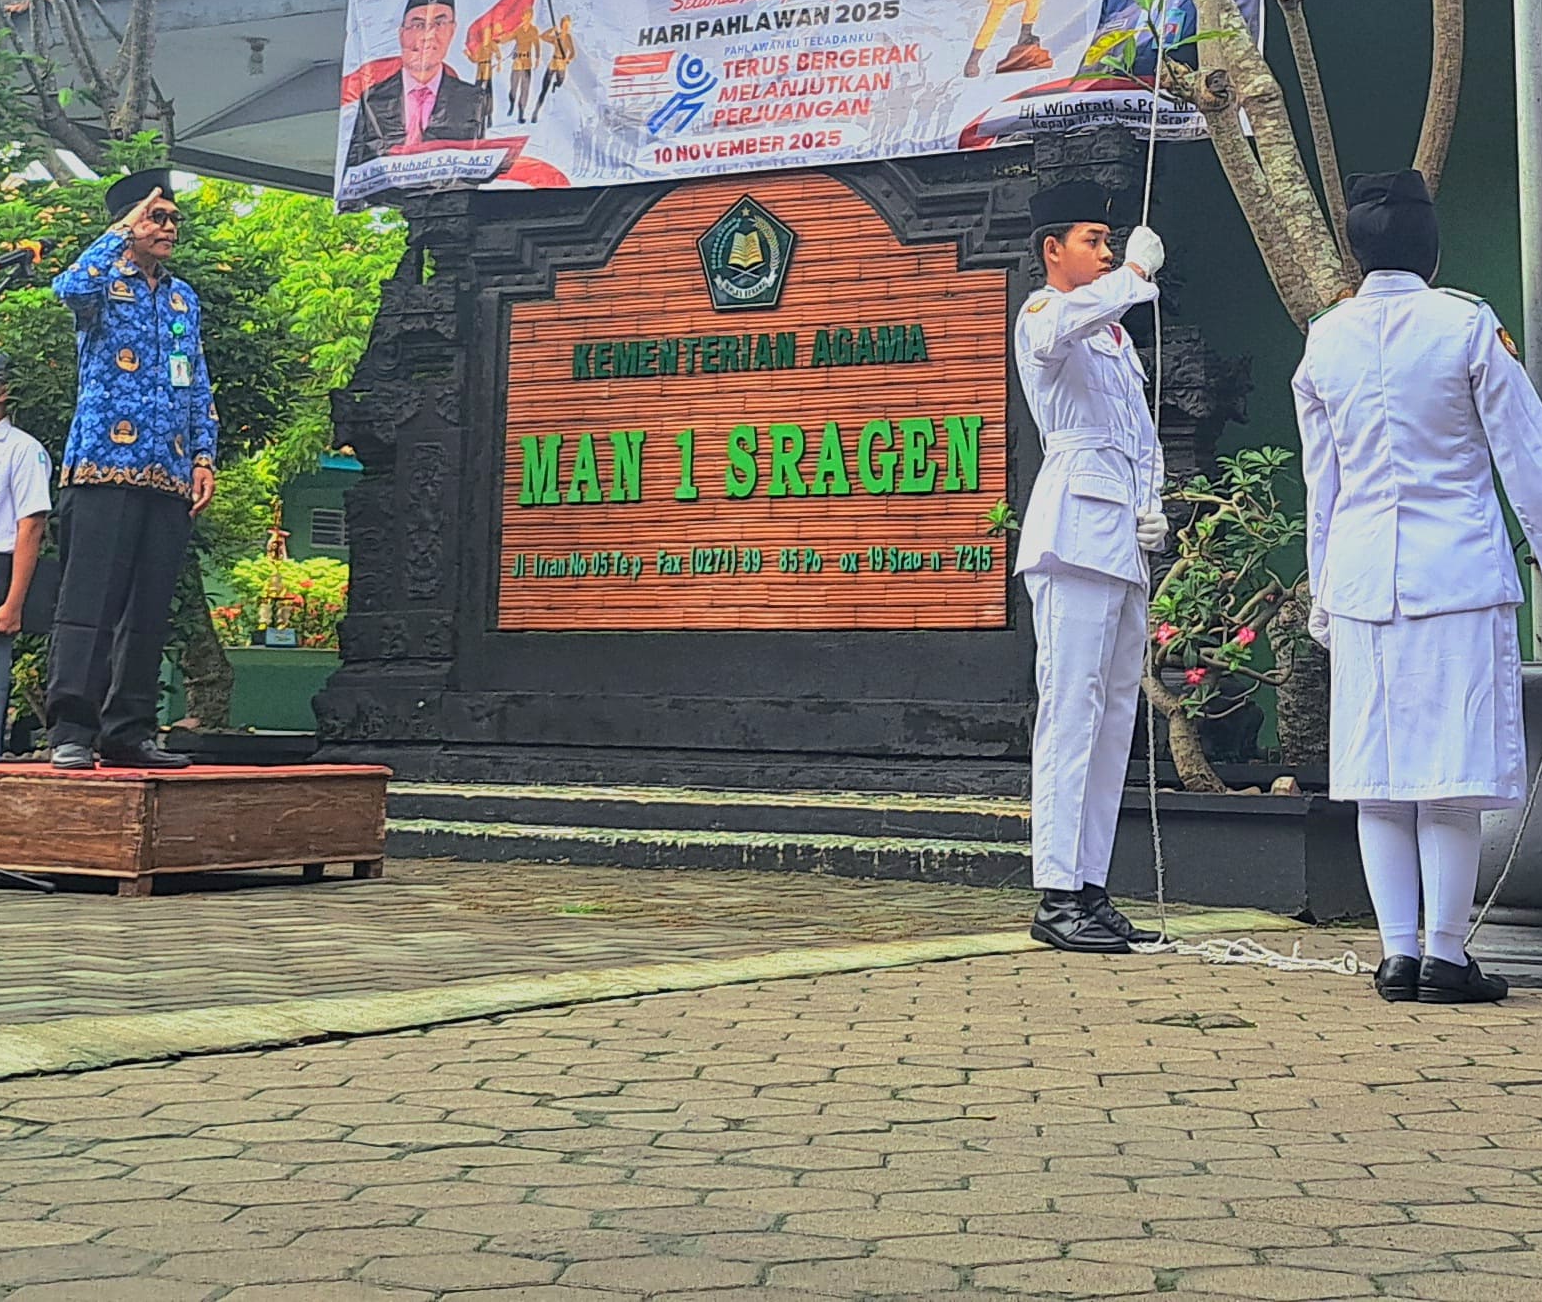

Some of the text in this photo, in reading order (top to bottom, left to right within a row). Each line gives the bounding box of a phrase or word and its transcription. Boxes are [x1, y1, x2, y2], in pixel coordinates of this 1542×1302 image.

[638, 0, 900, 46] HARI PAHLAWAN 2025
[723, 33, 874, 56] PAHLAWANKU TELADANKU
[723, 43, 919, 80] TERUS BERGERAK
[717, 72, 891, 103] MELANJUTKAN
[712, 98, 872, 128] PERJUANGAN
[1020, 103, 1040, 119] Hj.
[1032, 117, 1076, 130] Kepala
[654, 130, 842, 164] 10 NOVEMBER 2025
[571, 323, 929, 381] KEMENTERIAN AGAMA
[517, 414, 984, 507] MAN 1 SRAGEN
[569, 551, 587, 576] No
[657, 549, 683, 575] Fax
[689, 544, 738, 577] (0271)
